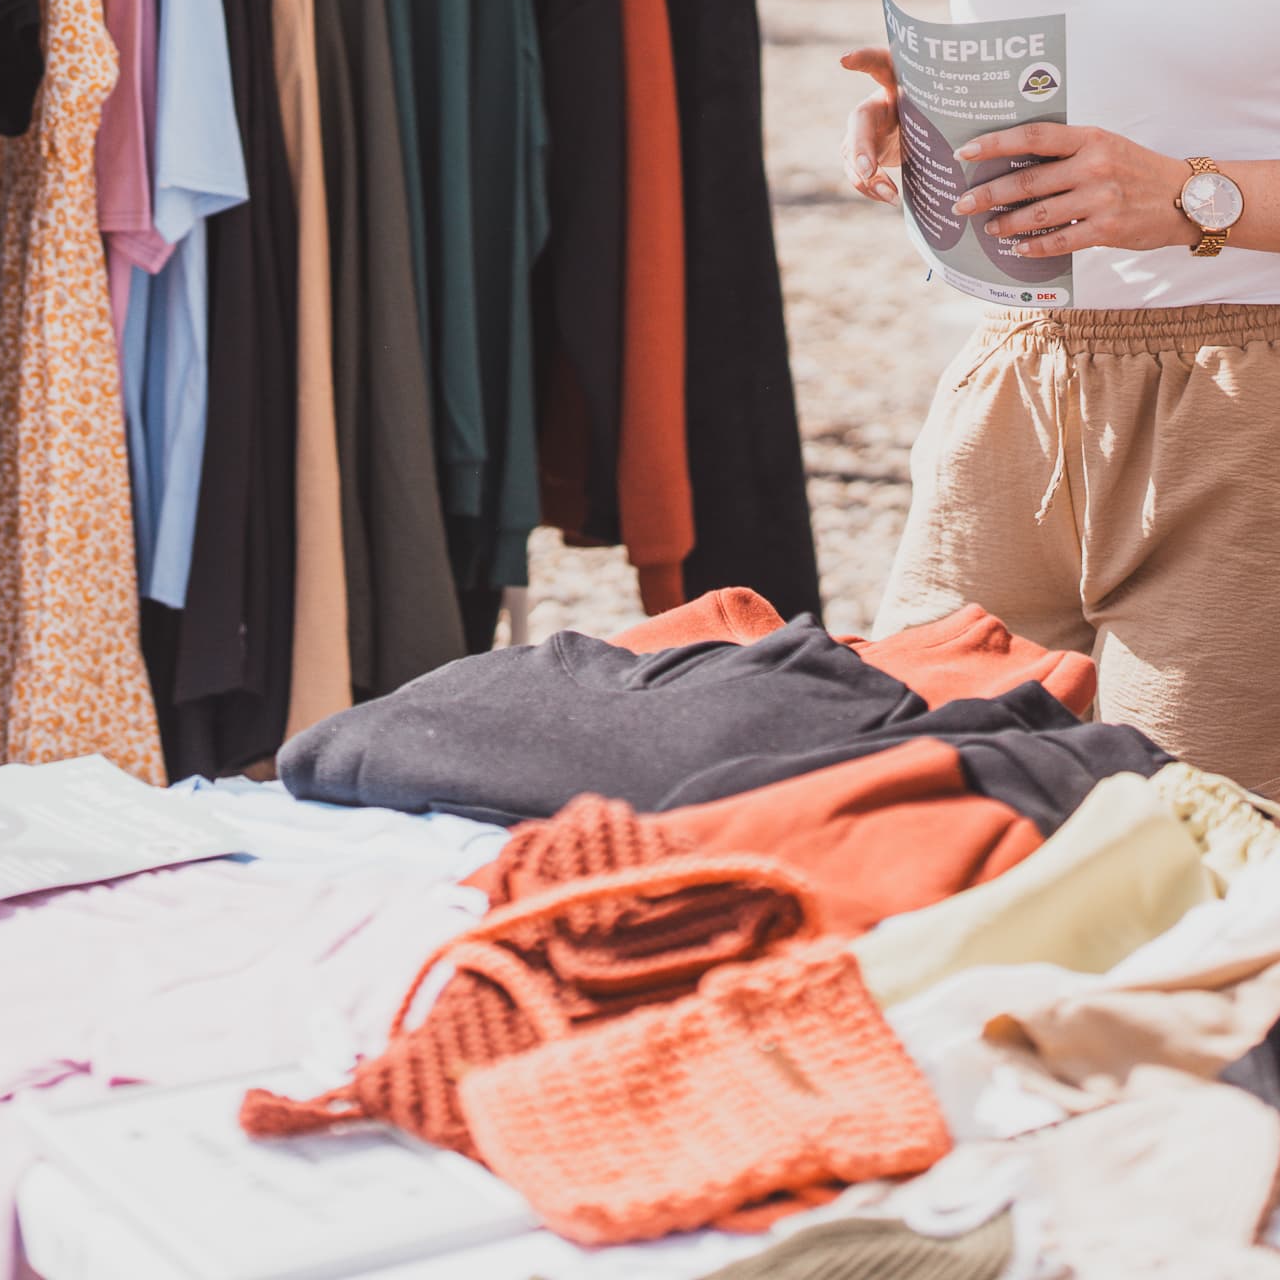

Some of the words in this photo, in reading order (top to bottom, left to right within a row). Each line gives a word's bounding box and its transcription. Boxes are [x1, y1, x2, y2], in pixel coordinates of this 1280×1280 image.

[923, 33, 1045, 63] TEPLICE
[932, 81, 945, 92] 14
[954, 85, 969, 95] 20
[941, 97, 967, 109] park
[969, 100, 977, 109] u
